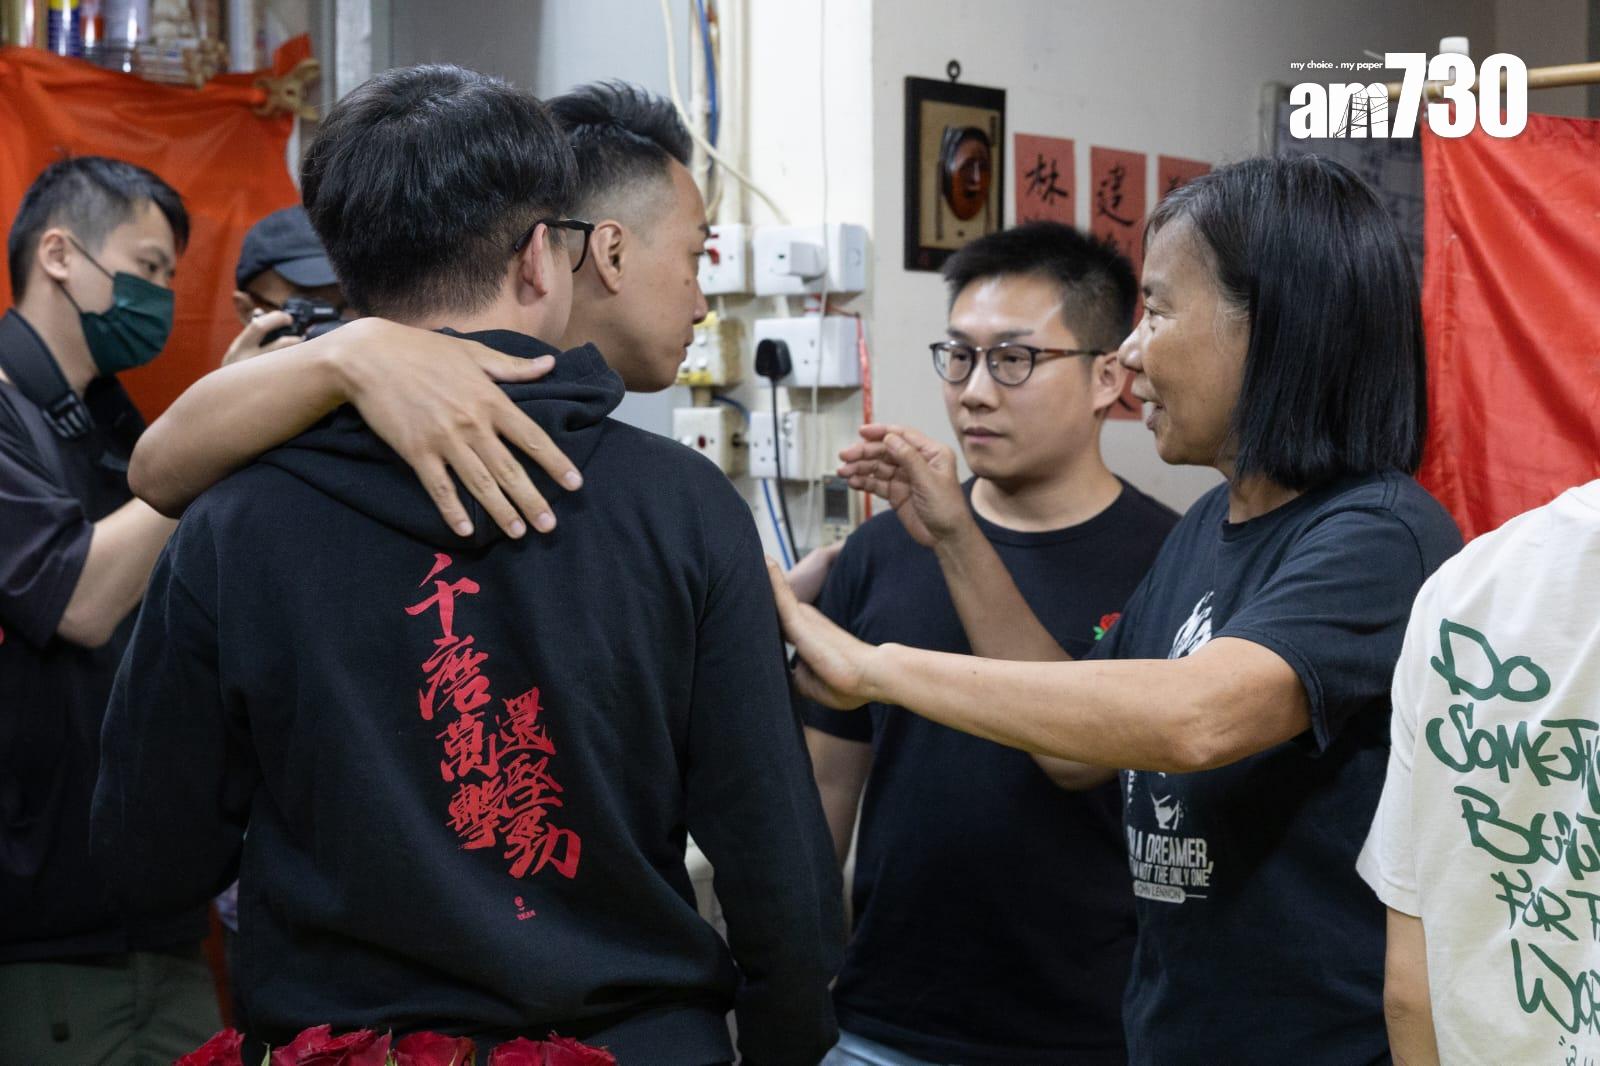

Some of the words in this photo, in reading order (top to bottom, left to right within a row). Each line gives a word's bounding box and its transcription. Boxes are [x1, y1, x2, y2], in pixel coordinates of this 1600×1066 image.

[1430, 618, 1551, 702] Do
[1154, 864, 1168, 884] THE
[1169, 866, 1190, 886] ONLY
[1191, 868, 1210, 887] ONE
